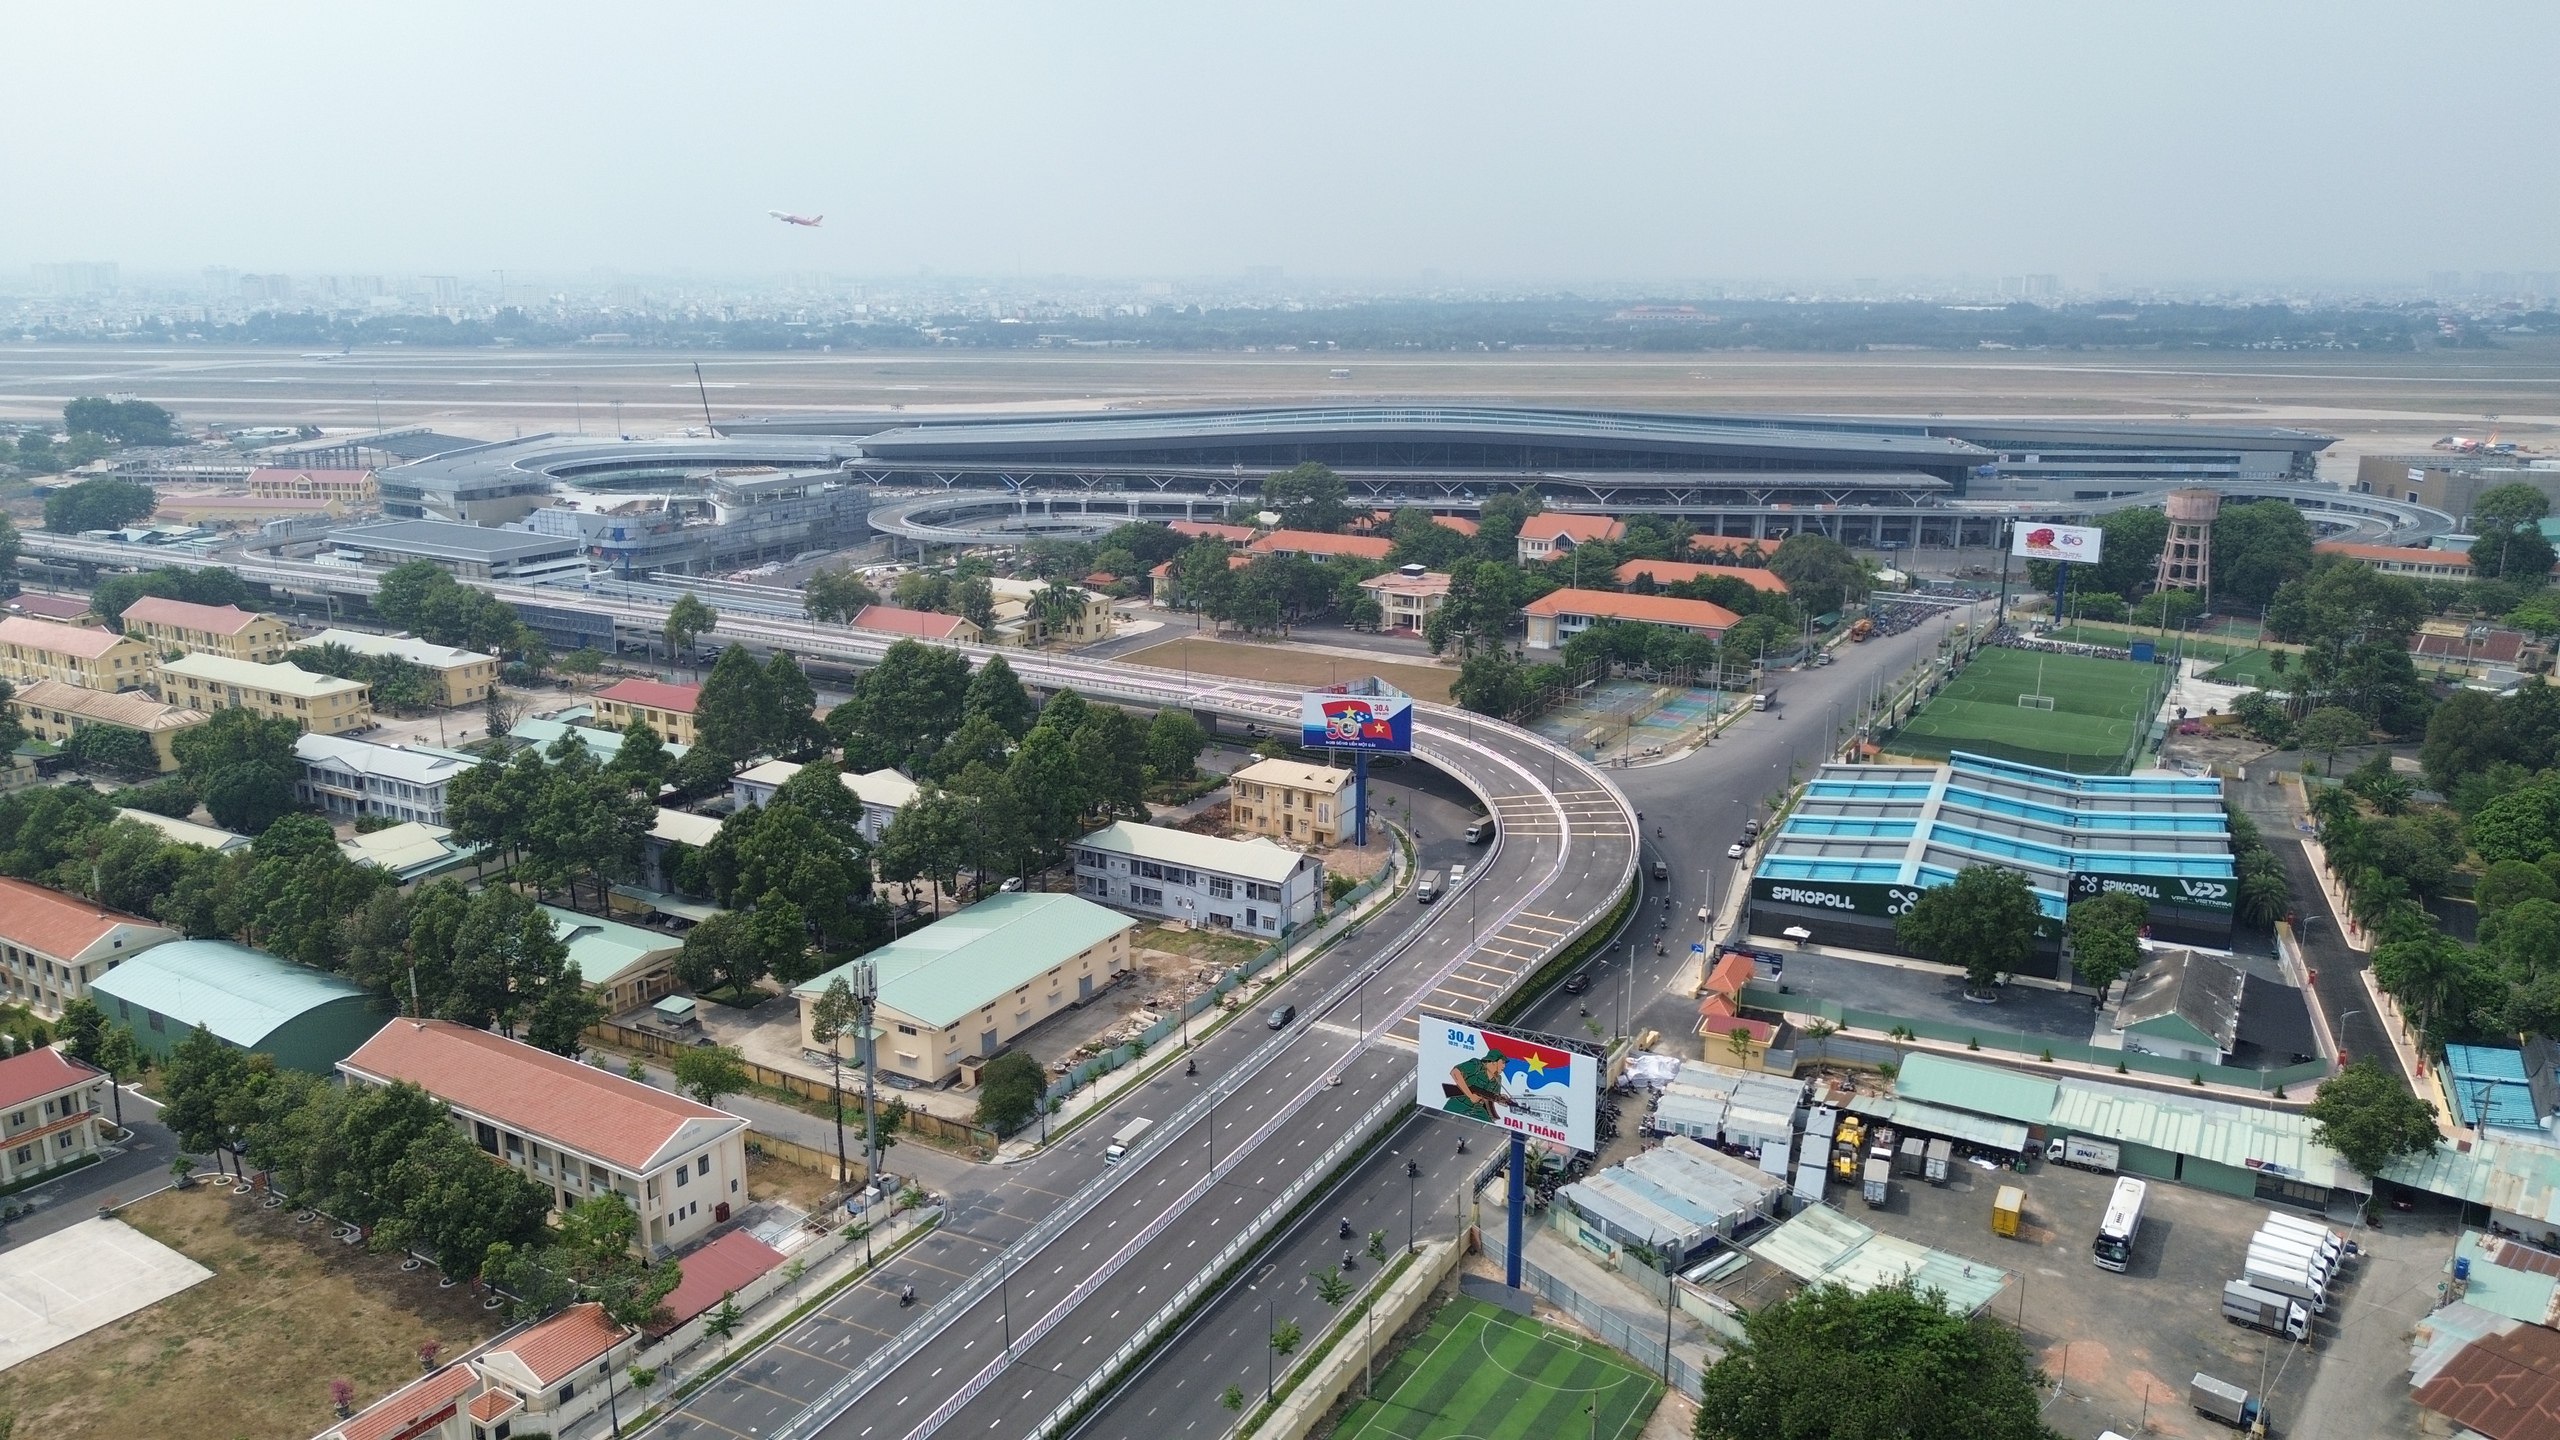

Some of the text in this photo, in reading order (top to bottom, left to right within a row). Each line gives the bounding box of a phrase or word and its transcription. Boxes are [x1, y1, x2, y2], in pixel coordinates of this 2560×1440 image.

[1374, 704, 1389, 712] 30.4
[1325, 717, 1359, 740] 50
[1771, 886, 1855, 910] SPIKOPOLL
[2102, 879, 2160, 899] SPIKOPOLL
[2194, 898, 2232, 907] VIETNAM
[1448, 1029, 1475, 1045] 30.4
